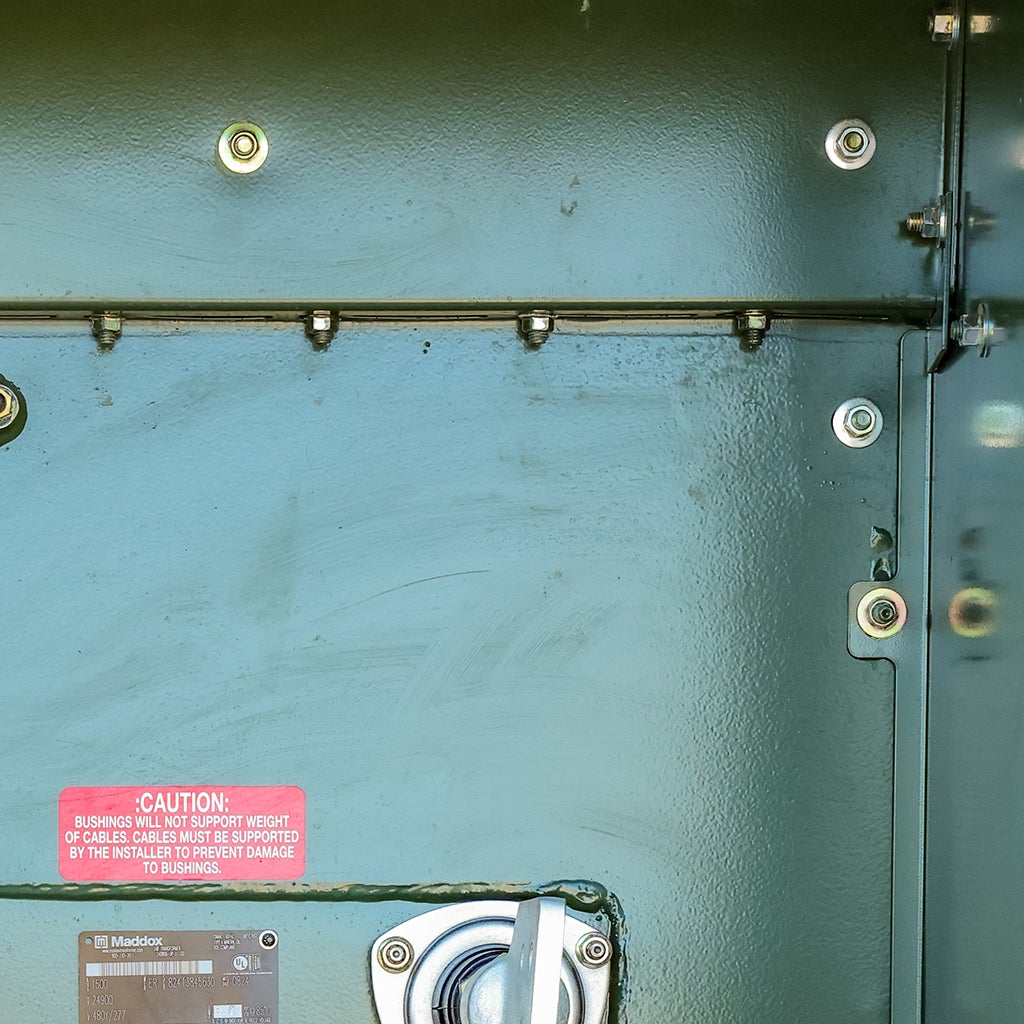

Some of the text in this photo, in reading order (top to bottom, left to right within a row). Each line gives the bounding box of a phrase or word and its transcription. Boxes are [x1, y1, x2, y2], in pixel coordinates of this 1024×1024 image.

[75, 815, 290, 828] BUSHINGS WILL NOT SUPPORT WEIGHT
[65, 830, 299, 843] OF CABLES. CABLES MUST BE SUPPORTED
[70, 846, 294, 859] BY THE INSTALLER TO PREVENT DAMAGE
[143, 862, 221, 874] TO BUSHINGS.
[111, 936, 163, 947] Maddox
